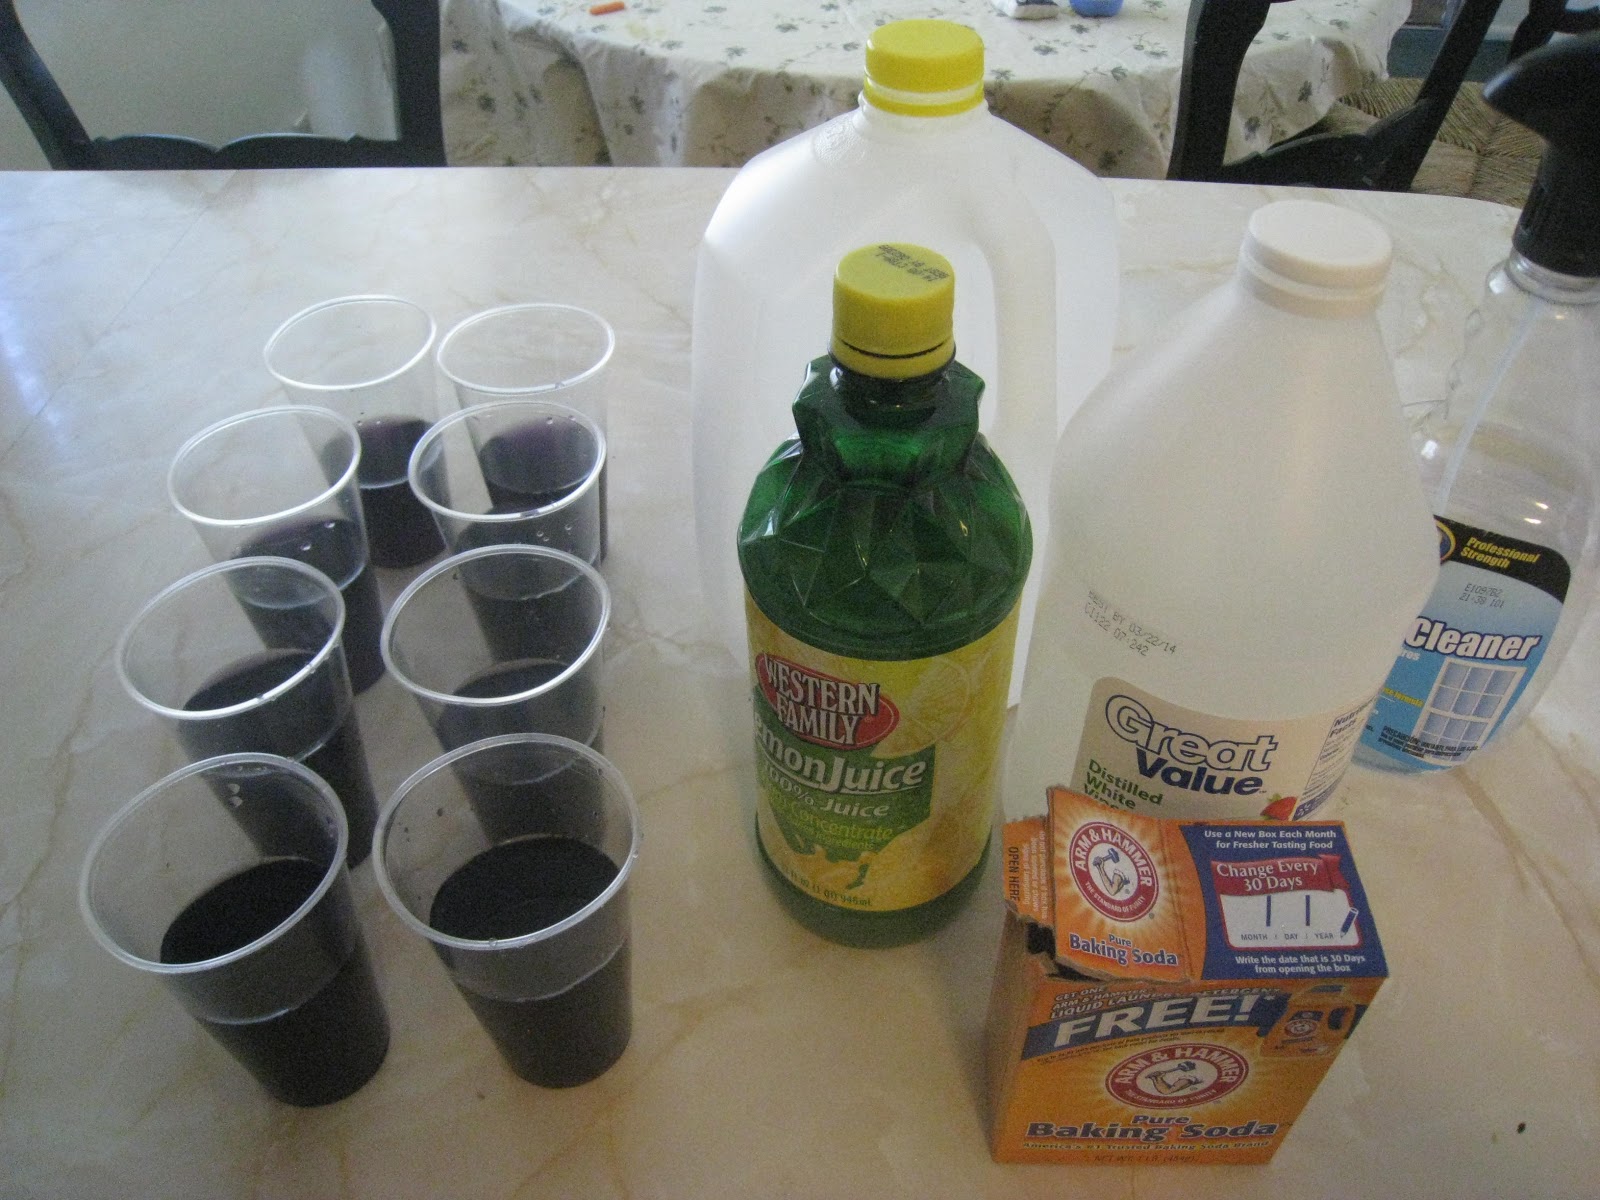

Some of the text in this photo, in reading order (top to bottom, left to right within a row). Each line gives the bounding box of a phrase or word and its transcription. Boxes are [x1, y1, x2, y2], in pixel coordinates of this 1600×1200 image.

[1460, 546, 1512, 569] Strength
[1466, 537, 1541, 563] Professional
[1112, 611, 1125, 625] BY
[1128, 623, 1177, 655] 03/22/14
[1404, 616, 1543, 660] Cleaner
[763, 652, 880, 716] WESTERN
[776, 694, 861, 746] FAMILY
[1105, 694, 1279, 772] Great
[1088, 758, 1164, 806] Distilled
[1136, 747, 1263, 796] Value
[1086, 771, 1136, 810] White
[820, 798, 890, 818] Juice
[791, 800, 893, 841] Concentrate
[1204, 830, 1222, 838] Use
[1234, 830, 1256, 838] New
[1258, 830, 1276, 838] Box
[1279, 830, 1302, 838] Each
[1304, 830, 1337, 838] Month
[1074, 827, 1153, 887] ARM & HAMMER
[1216, 841, 1333, 851] for Fresher Tasting Food
[1008, 847, 1020, 902] OPEN HERE
[1216, 860, 1318, 879] Change Every
[1244, 875, 1303, 892] 30 Days
[1084, 882, 1146, 913] THE STANDARD OF PURITY
[1108, 933, 1131, 948] Pure
[1240, 932, 1334, 941] MONTH DAY YEAR
[1068, 933, 1178, 967] Baking Soda
[1235, 956, 1259, 964] Write
[1261, 955, 1276, 964] the
[1280, 955, 1298, 964] date
[1300, 955, 1319, 963] that
[1344, 955, 1365, 963] Days
[1255, 964, 1351, 974] from opening the box
[1052, 1000, 1078, 1010] ARM
[1093, 989, 1147, 1000] HAMMER
[1056, 992, 1079, 1001] GET
[1050, 1001, 1104, 1019] LIQUID
[1115, 1047, 1241, 1084] ARM & HAMMER
[1134, 1092, 1177, 1105] STANDARD
[1026, 1119, 1278, 1143] Baking Soda
[1132, 1114, 1191, 1126] Pure
[1023, 1142, 1082, 1150] America's
[1155, 1143, 1196, 1151] Baking
[1232, 1140, 1270, 1149] Brand
